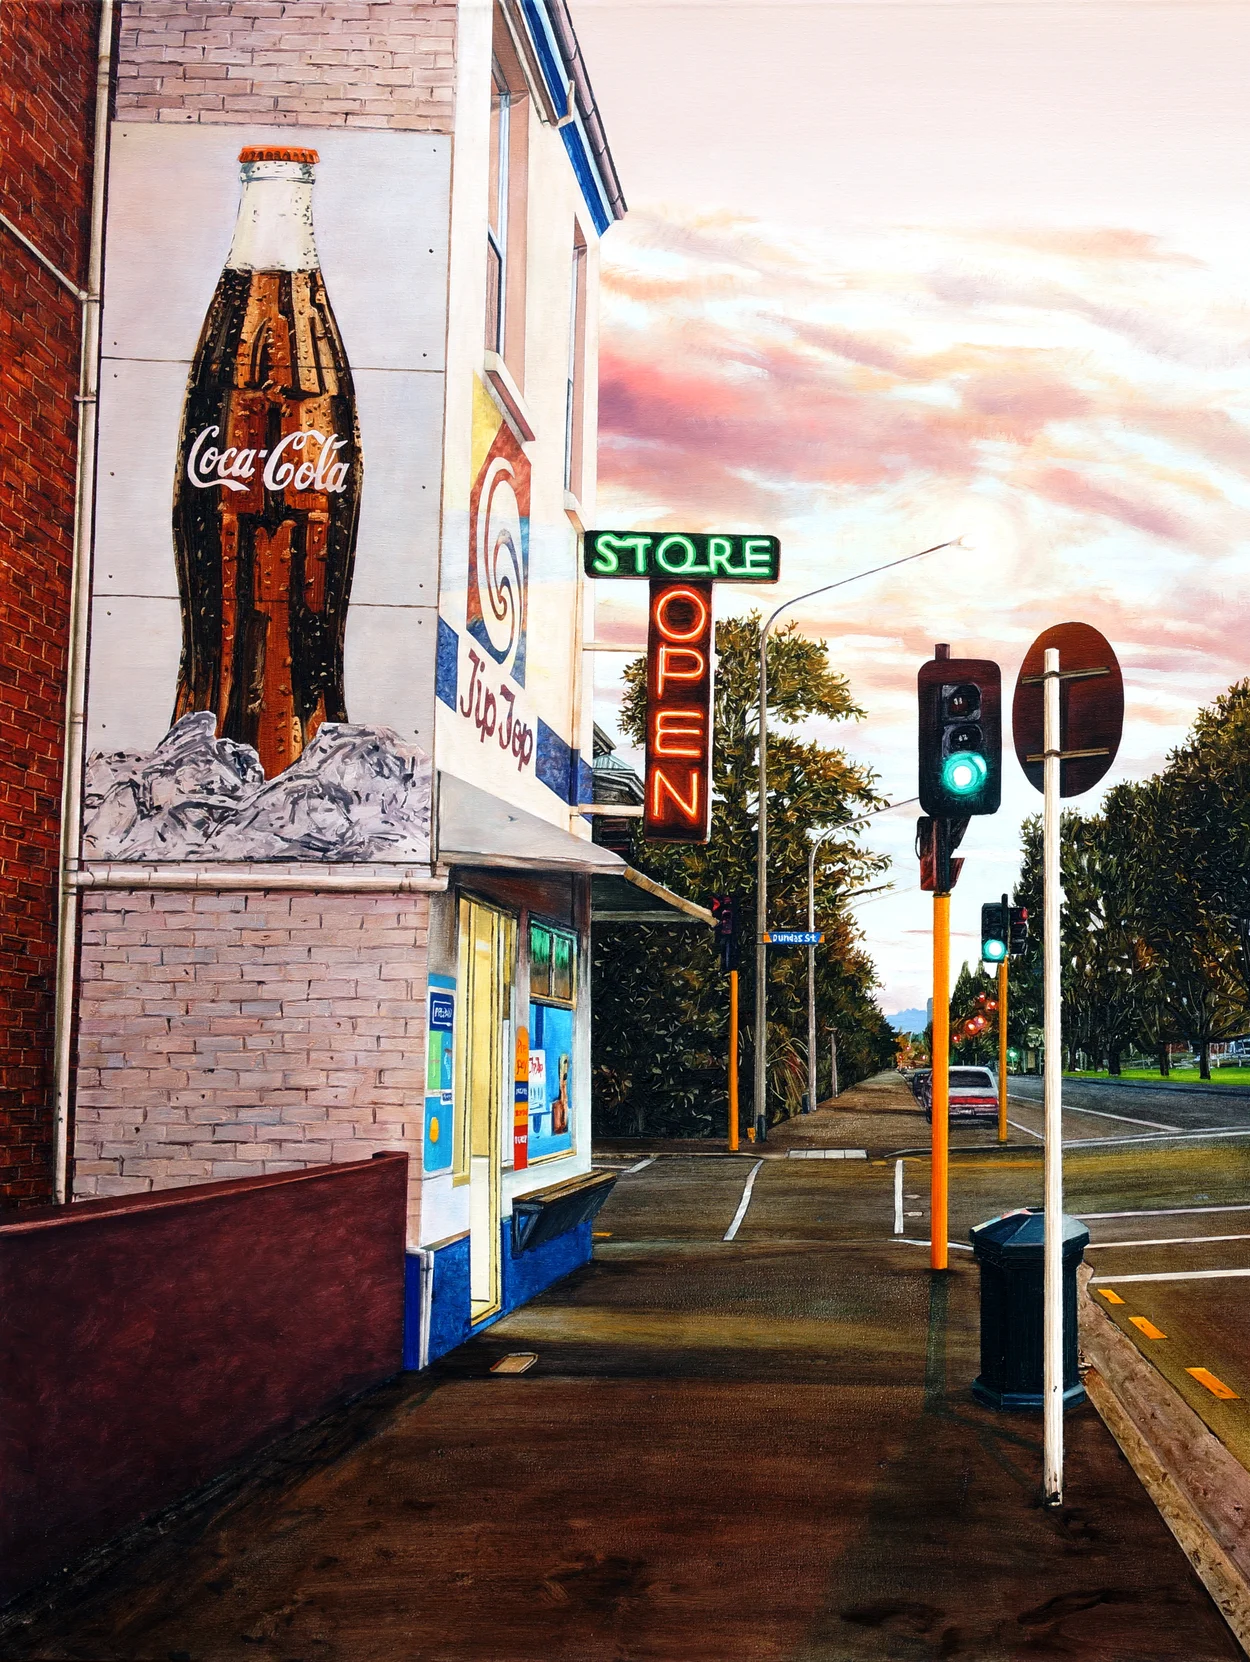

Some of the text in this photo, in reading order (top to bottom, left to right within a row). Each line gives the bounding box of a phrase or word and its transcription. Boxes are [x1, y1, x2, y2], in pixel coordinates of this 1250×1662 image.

[187, 425, 350, 494] Coca-Cola
[592, 533, 771, 575] STORE
[460, 648, 533, 772] Tip Top
[652, 586, 707, 822] OPEN
[772, 934, 817, 943] Dundas St
